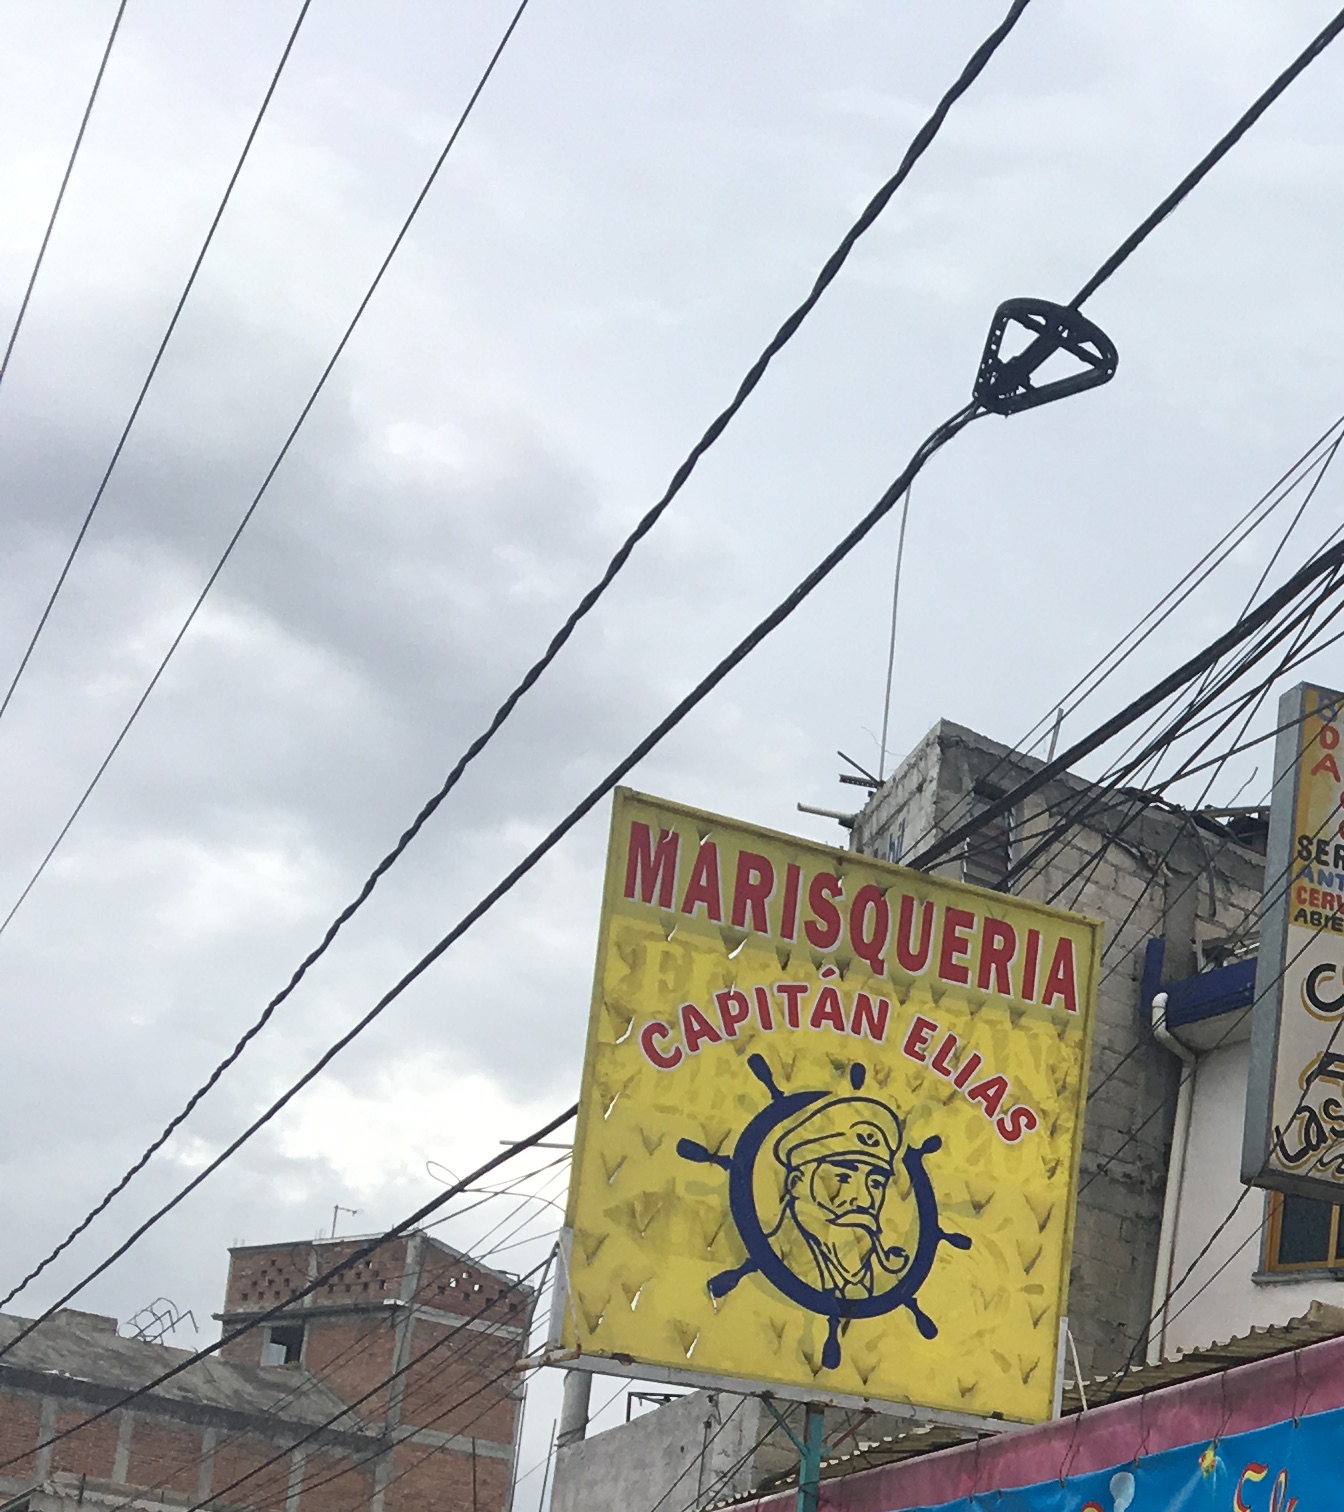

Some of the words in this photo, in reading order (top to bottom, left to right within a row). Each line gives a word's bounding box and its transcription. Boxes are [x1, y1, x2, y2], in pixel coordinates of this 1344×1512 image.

[622, 819, 1082, 1015] MARISQUERIA
[638, 965, 891, 1072] CAPITÁN
[902, 1012, 1040, 1146] ELIAS
